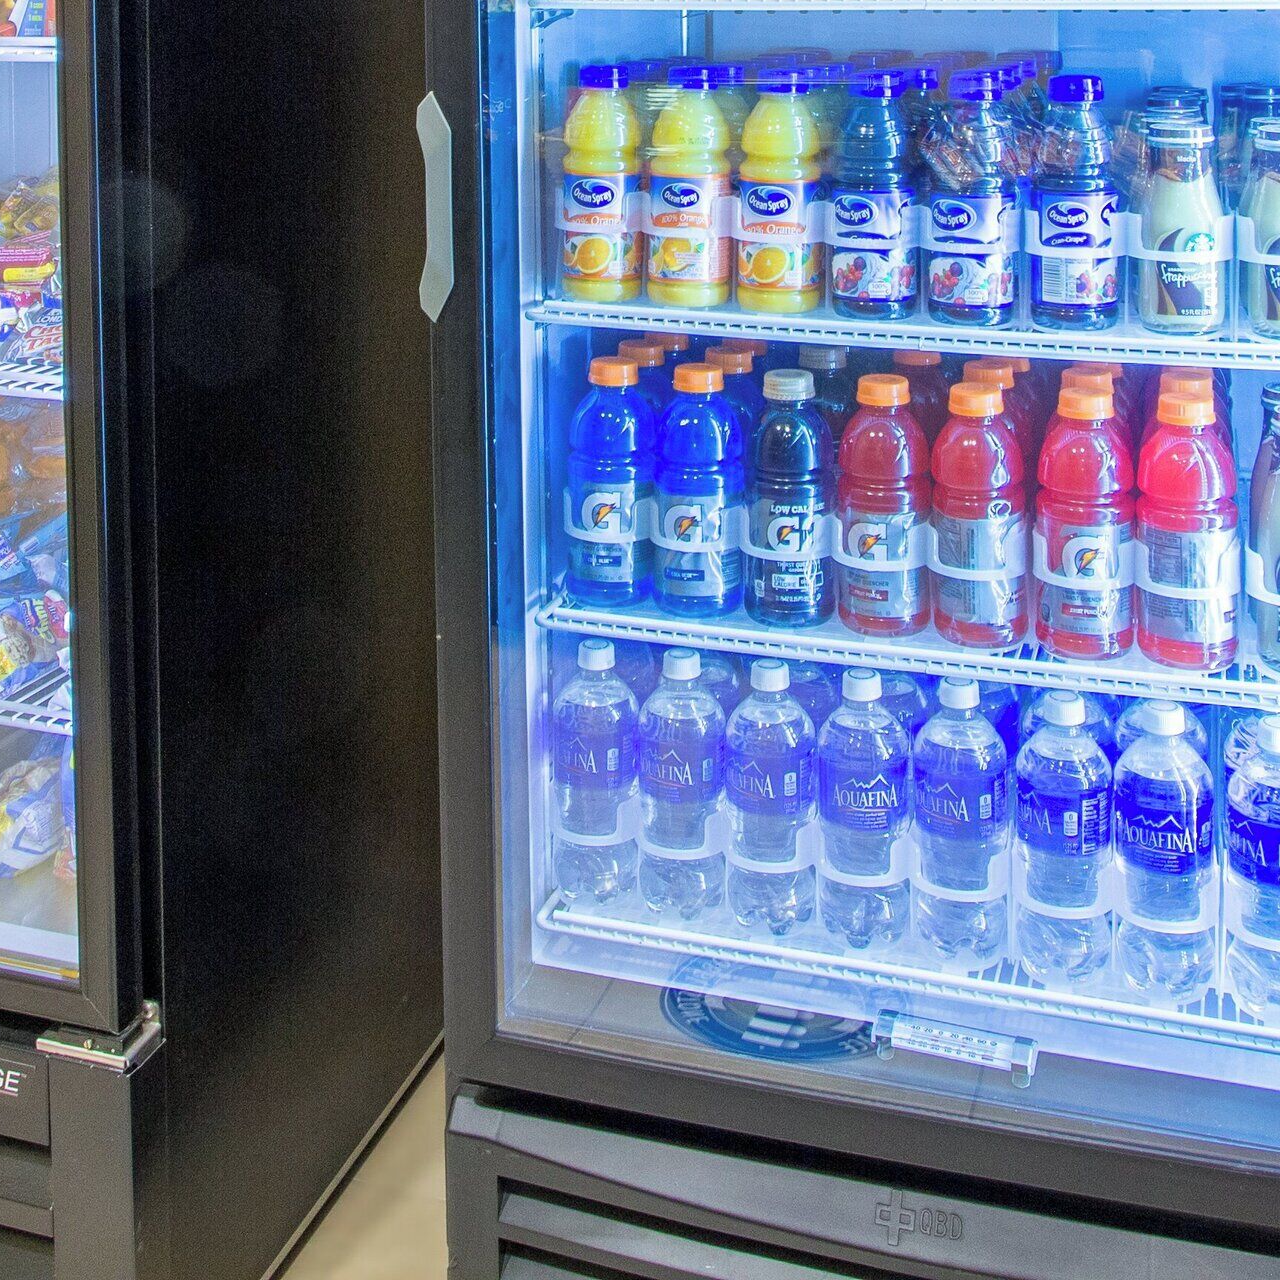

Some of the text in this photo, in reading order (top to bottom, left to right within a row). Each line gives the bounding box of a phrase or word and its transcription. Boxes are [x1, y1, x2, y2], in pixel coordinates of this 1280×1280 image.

[573, 188, 612, 205] Ocean Spray
[664, 191, 697, 205] Ocean Spray
[749, 196, 788, 213] Ocean Spray
[835, 205, 871, 222] Ocean Spray
[933, 209, 968, 227] Ocean Spray
[1049, 209, 1088, 226] Ocean Spray
[771, 505, 790, 514] LOW
[833, 783, 898, 808] AQUAFINA
[1123, 817, 1195, 853] AQUAFINA
[919, 1207, 963, 1241] QBD
